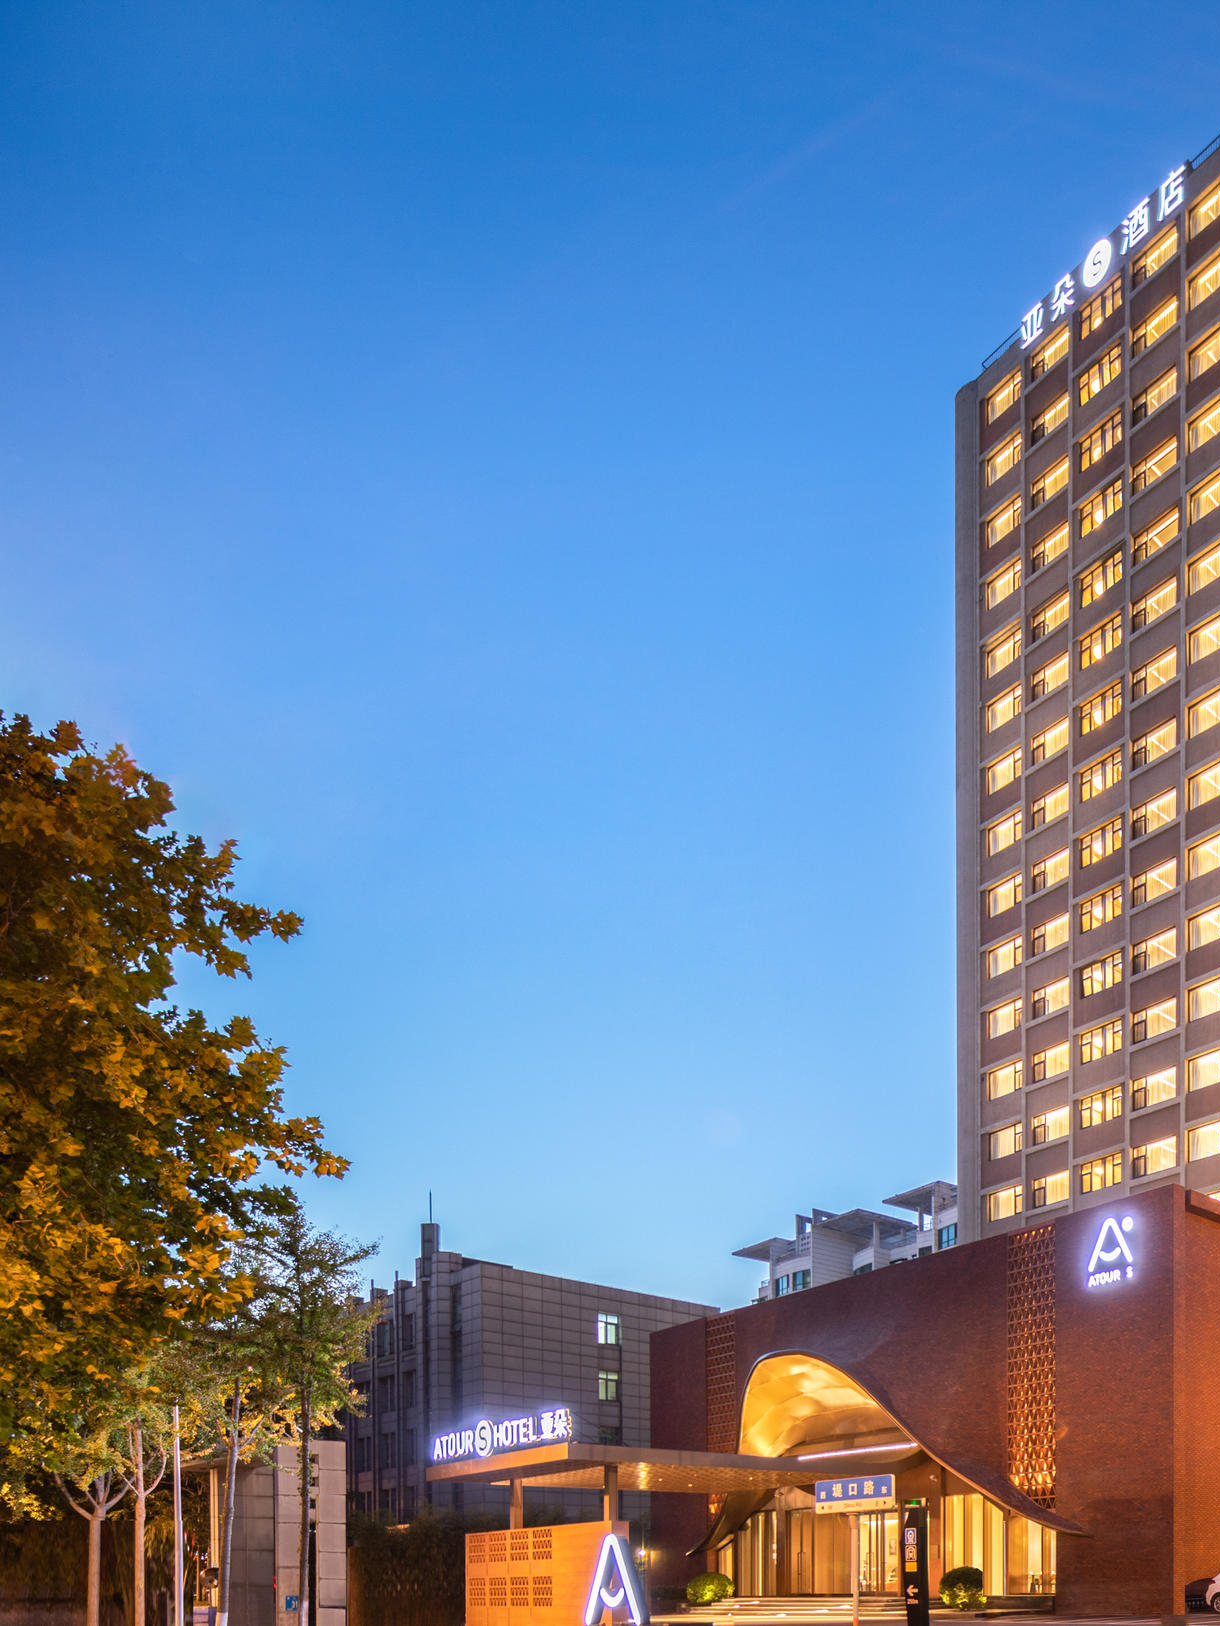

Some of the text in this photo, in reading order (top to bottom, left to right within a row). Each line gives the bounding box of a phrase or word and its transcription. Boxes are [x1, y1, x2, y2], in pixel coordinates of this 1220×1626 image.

[1020, 273, 1074, 349] 亚朵
[1120, 165, 1184, 254] 酒店
[1088, 1266, 1133, 1287] ATOUR S
[433, 1429, 474, 1461] ATOUR
[493, 1416, 540, 1448] HOTEL
[541, 1409, 571, 1439] 亚朵
[832, 1480, 874, 1498] 堤口路
